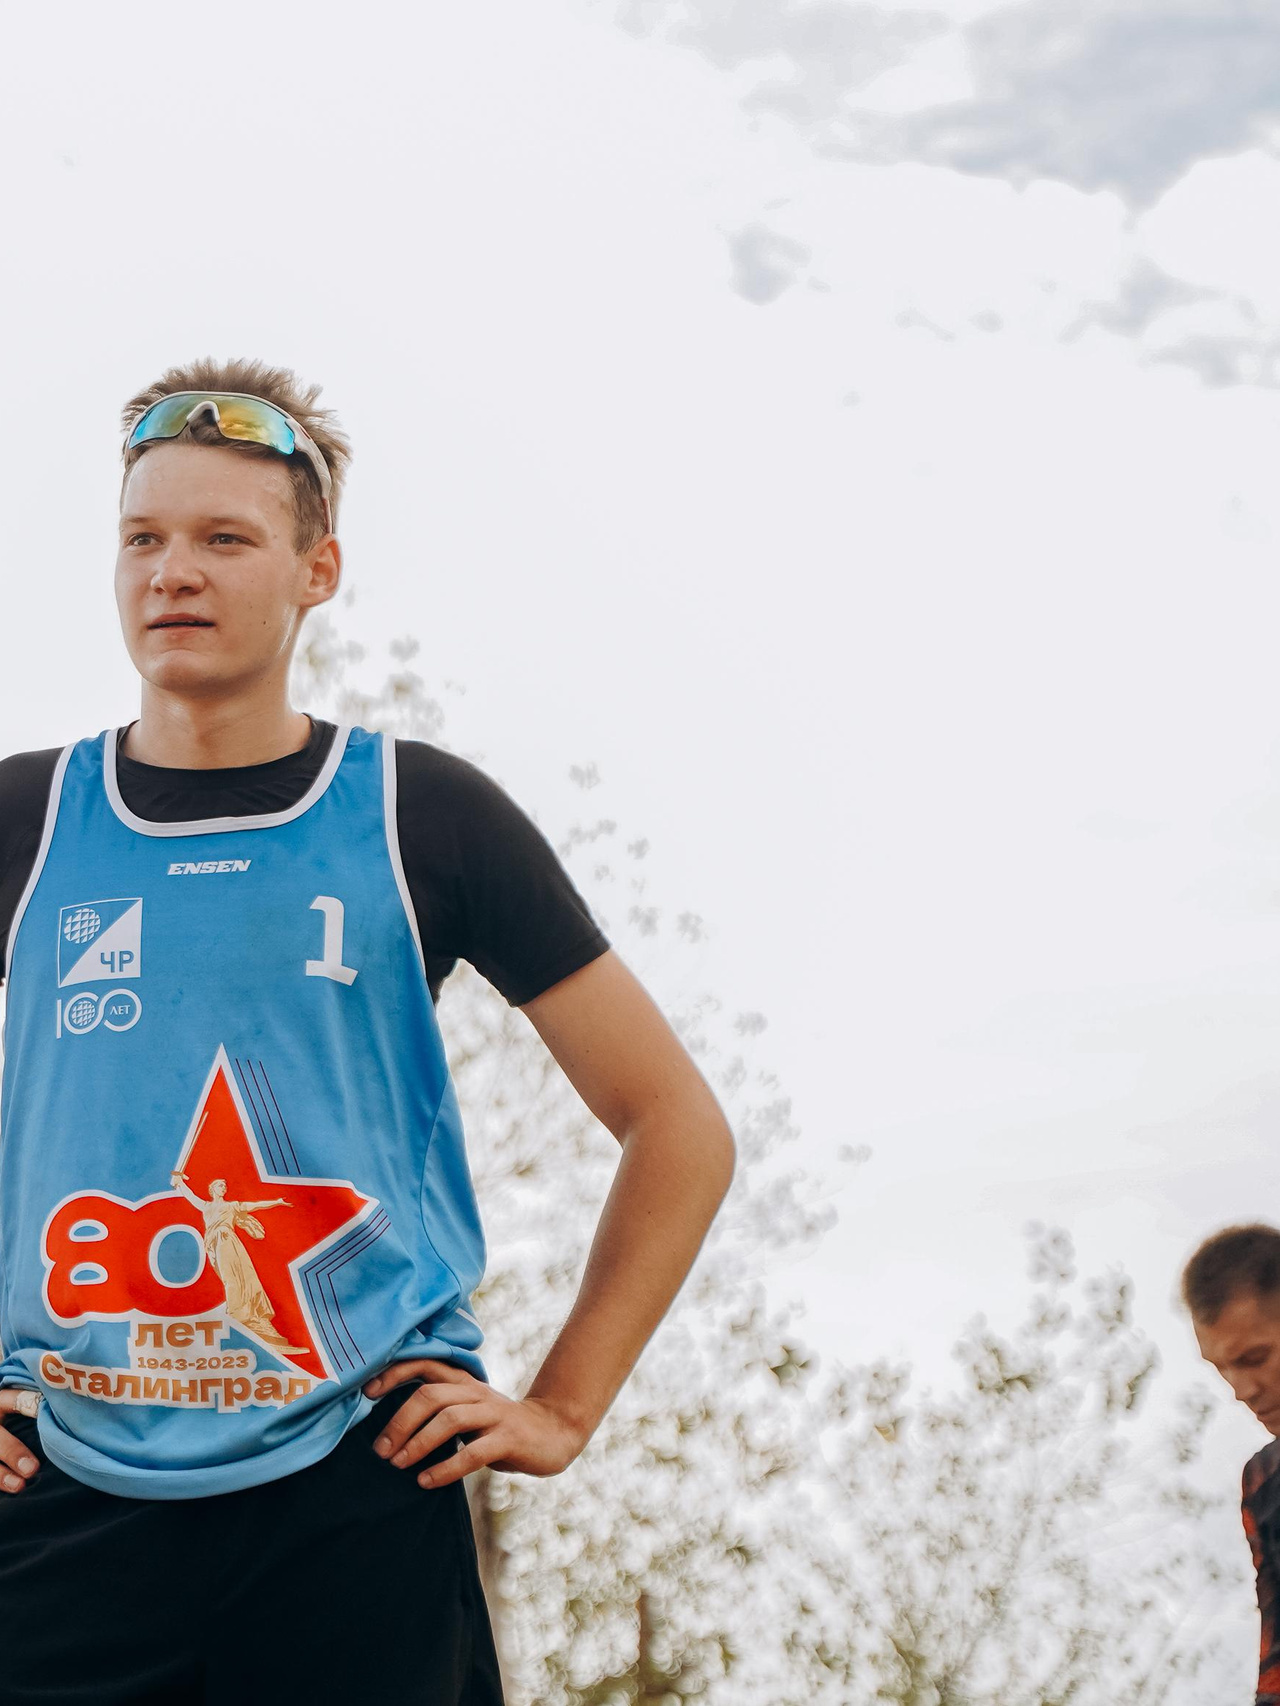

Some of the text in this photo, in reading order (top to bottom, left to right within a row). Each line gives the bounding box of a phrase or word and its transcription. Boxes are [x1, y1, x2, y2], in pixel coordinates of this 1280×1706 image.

[167, 859, 251, 876] ENSEN
[305, 895, 358, 986] 1
[99, 949, 135, 974] ЧР
[42, 1191, 228, 1325] 80
[134, 1319, 223, 1349] лет
[136, 1355, 249, 1371] 1943-2023
[40, 1353, 312, 1407] Сталинград
